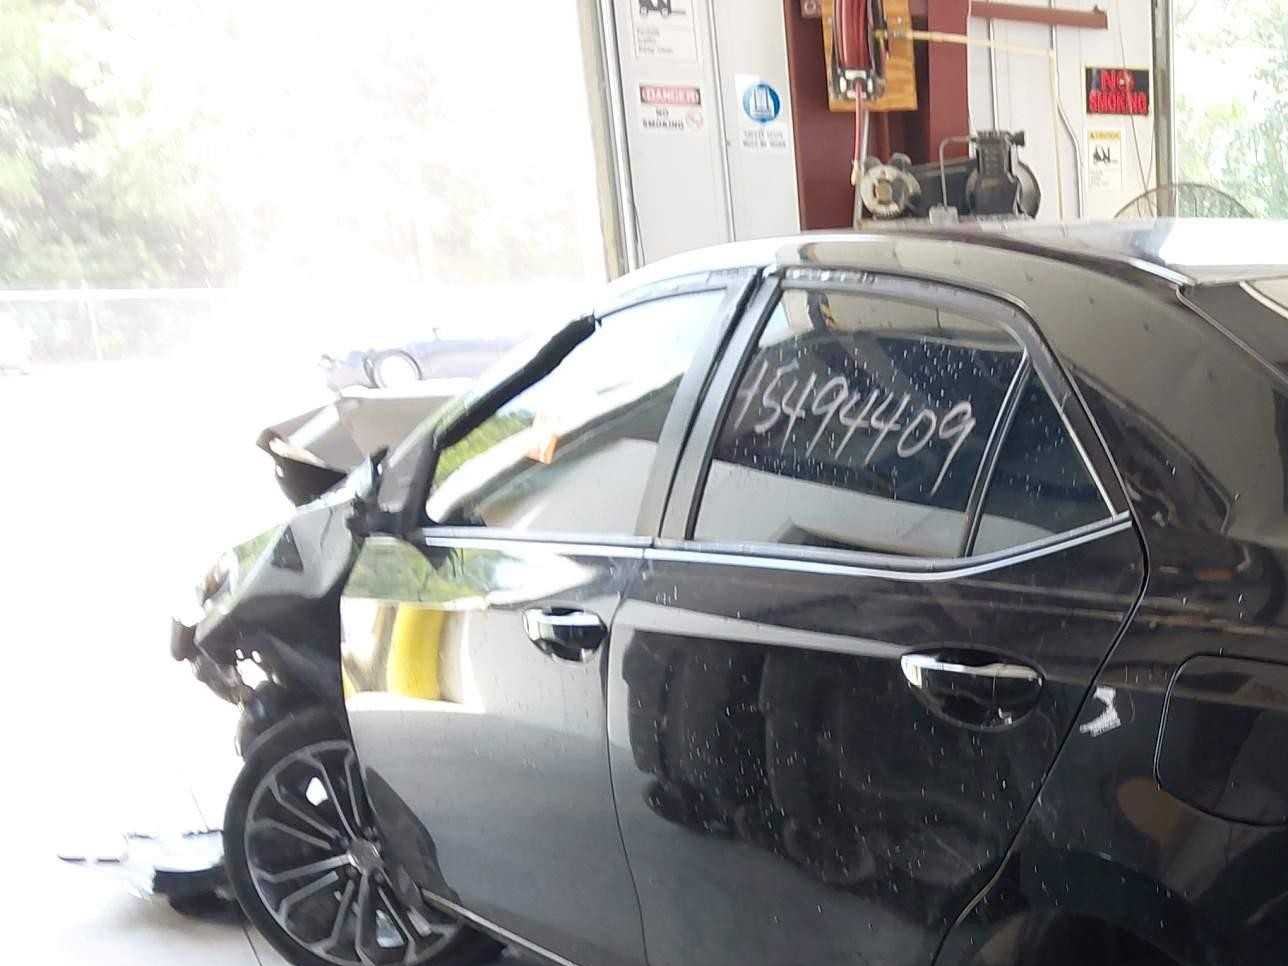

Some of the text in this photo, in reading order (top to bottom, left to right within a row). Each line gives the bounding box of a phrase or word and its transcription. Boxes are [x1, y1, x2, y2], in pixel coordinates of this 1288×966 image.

[1101, 69, 1134, 91] NO
[1089, 90, 1148, 113] SMOKING
[655, 106, 669, 117] NO
[642, 118, 685, 131] SMOKING
